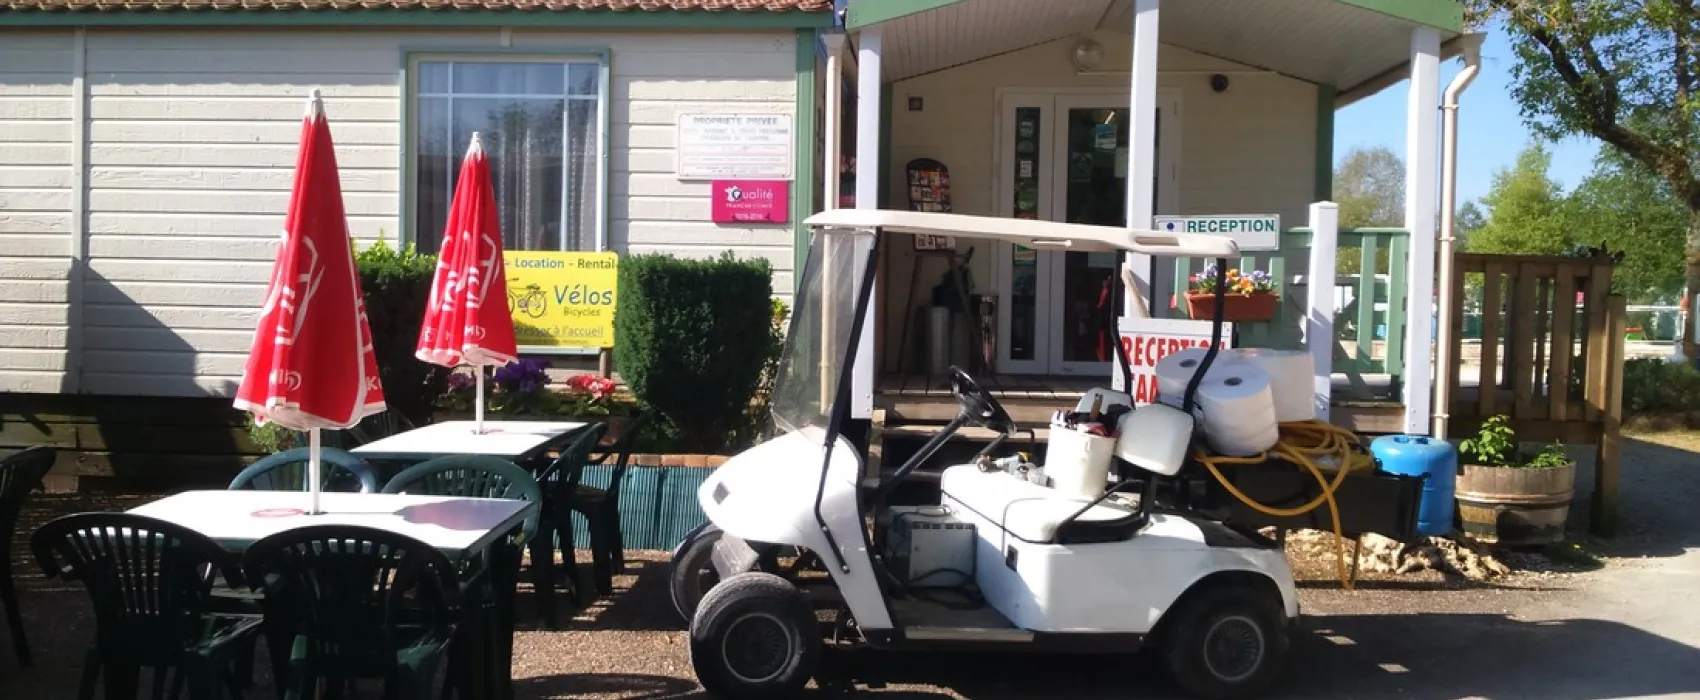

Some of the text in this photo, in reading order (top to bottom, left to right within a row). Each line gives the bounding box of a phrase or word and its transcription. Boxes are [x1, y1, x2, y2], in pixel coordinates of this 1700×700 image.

[1187, 219, 1275, 233] RECEPTION
[515, 257, 565, 269] Location
[577, 258, 615, 269] Rental
[554, 283, 613, 306] Vélos
[563, 307, 601, 318] Bicycles
